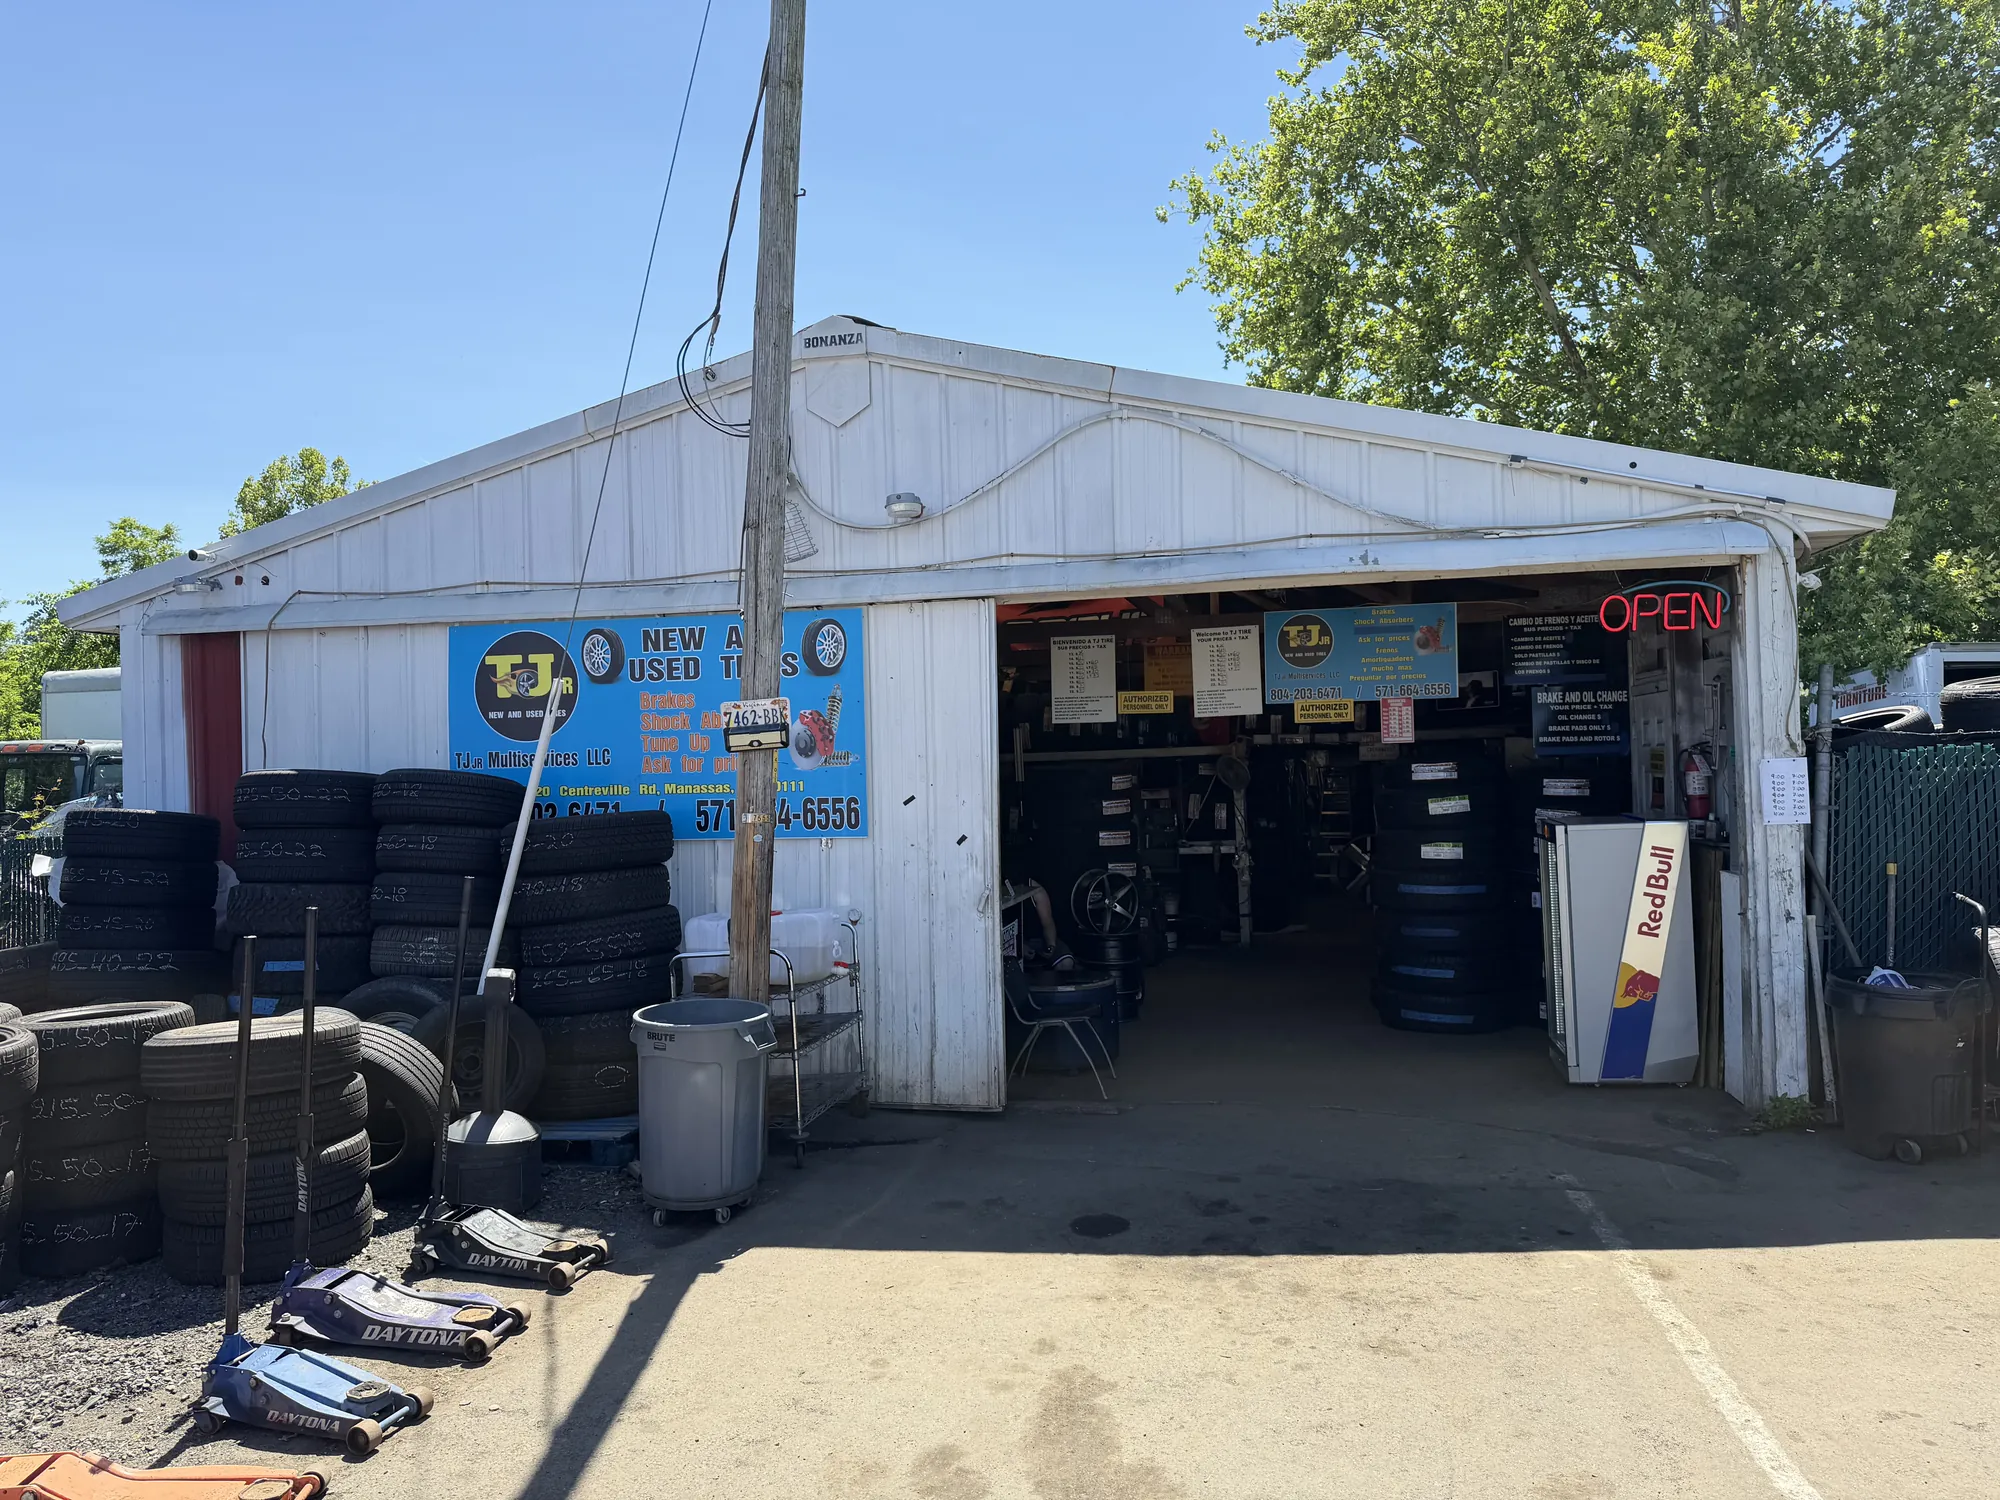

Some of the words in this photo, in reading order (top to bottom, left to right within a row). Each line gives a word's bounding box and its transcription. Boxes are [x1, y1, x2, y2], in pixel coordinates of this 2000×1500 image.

[804, 333, 863, 348] BONANZA
[1509, 617, 1533, 627] CAMBIO
[1534, 617, 1543, 625] DE
[1544, 616, 1569, 625] FRENOS
[1576, 614, 1599, 623] ACEITE
[1600, 591, 1721, 632] OPEN
[641, 627, 706, 653] NEW
[1283, 625, 1320, 647] TJ
[1389, 635, 1410, 643] prices
[485, 653, 554, 698] TJ
[629, 656, 701, 683] USED
[719, 652, 799, 680] TIS
[1289, 672, 1326, 680] Multiservices
[640, 691, 695, 710] Brakes
[1123, 695, 1169, 703] AUTHORIZED
[1270, 687, 1341, 700] 804-203-6471
[1376, 683, 1450, 697] 571-664-6556
[1537, 692, 1564, 704] BRAKE
[1565, 691, 1581, 703] AND
[1582, 691, 1596, 702] OIL
[1597, 690, 1628, 702] CHANGE
[1836, 684, 1887, 709] FURNITURE
[488, 711, 504, 719] NEW
[508, 710, 522, 719] AND
[526, 710, 544, 718] USED
[1123, 703, 1154, 711] PERSONNEL
[1300, 703, 1348, 711] AUTHORIZED
[641, 712, 690, 731] Shock
[641, 735, 679, 752] Tune
[689, 734, 710, 752] Up
[455, 752, 470, 769] TJ
[472, 757, 483, 769] JR
[488, 751, 578, 769] Multisevices
[587, 748, 611, 766] LLC
[642, 756, 671, 774] Ask
[681, 755, 704, 773] for
[714, 754, 739, 774] pri
[560, 785, 630, 796] Centreville
[639, 784, 661, 796] Rd,
[664, 783, 735, 796] Manassas,
[696, 796, 860, 832] 5714-6556
[1646, 845, 1675, 891] Bull
[1637, 891, 1665, 938] Red
[647, 1031, 675, 1042] BRUTE
[361, 1323, 466, 1347] DAYTONA
[266, 1409, 341, 1433] DAYTONA
